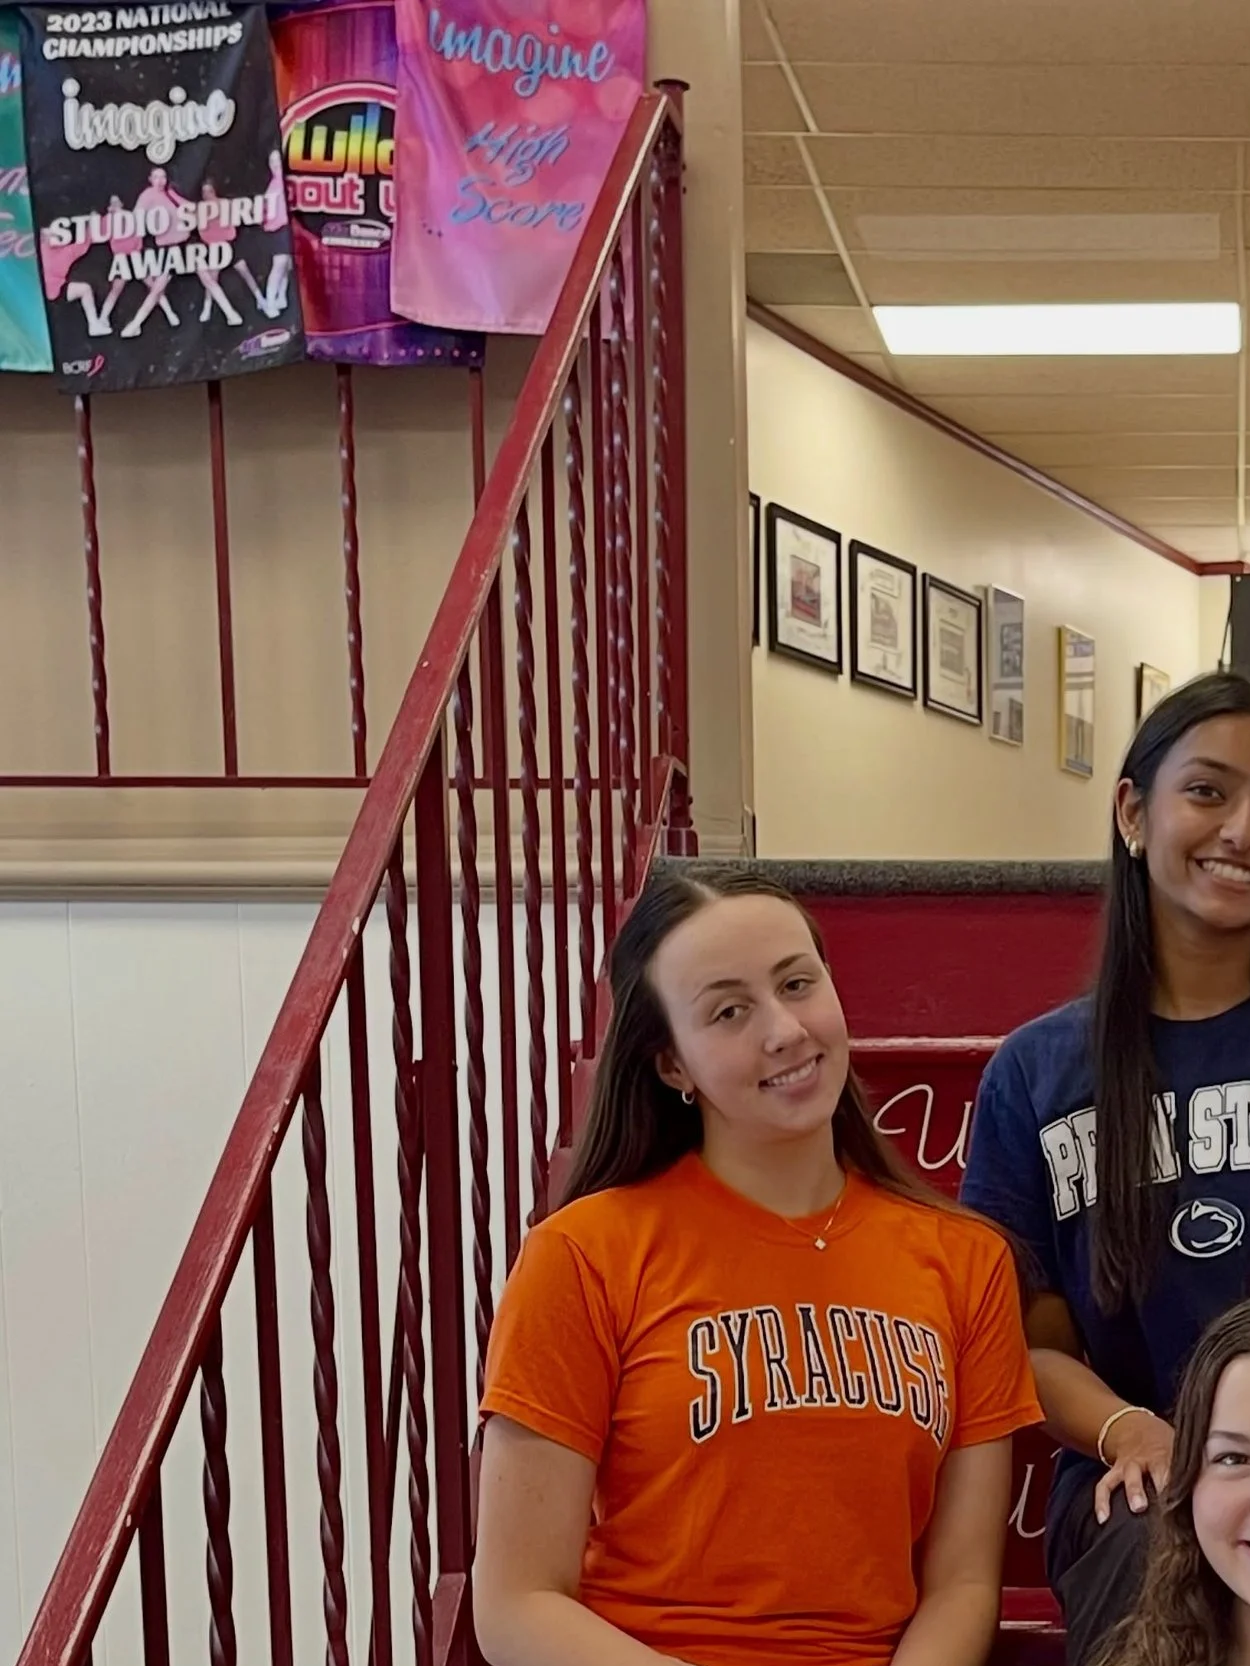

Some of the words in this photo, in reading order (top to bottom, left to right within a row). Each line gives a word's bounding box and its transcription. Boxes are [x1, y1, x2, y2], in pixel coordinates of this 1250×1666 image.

[42, 21, 243, 60] CHAMPIONSHIPS
[46, 12, 113, 33] 2023
[115, 0, 232, 31] NATIONAL
[428, 8, 615, 98] imagine
[61, 77, 236, 165] imagine
[464, 121, 571, 187] High
[49, 205, 170, 247] STUDIO
[176, 193, 280, 231] SPIRIT
[450, 174, 586, 232] Score
[107, 241, 235, 283] AWARD
[687, 1303, 951, 1449] SYRACUSE
